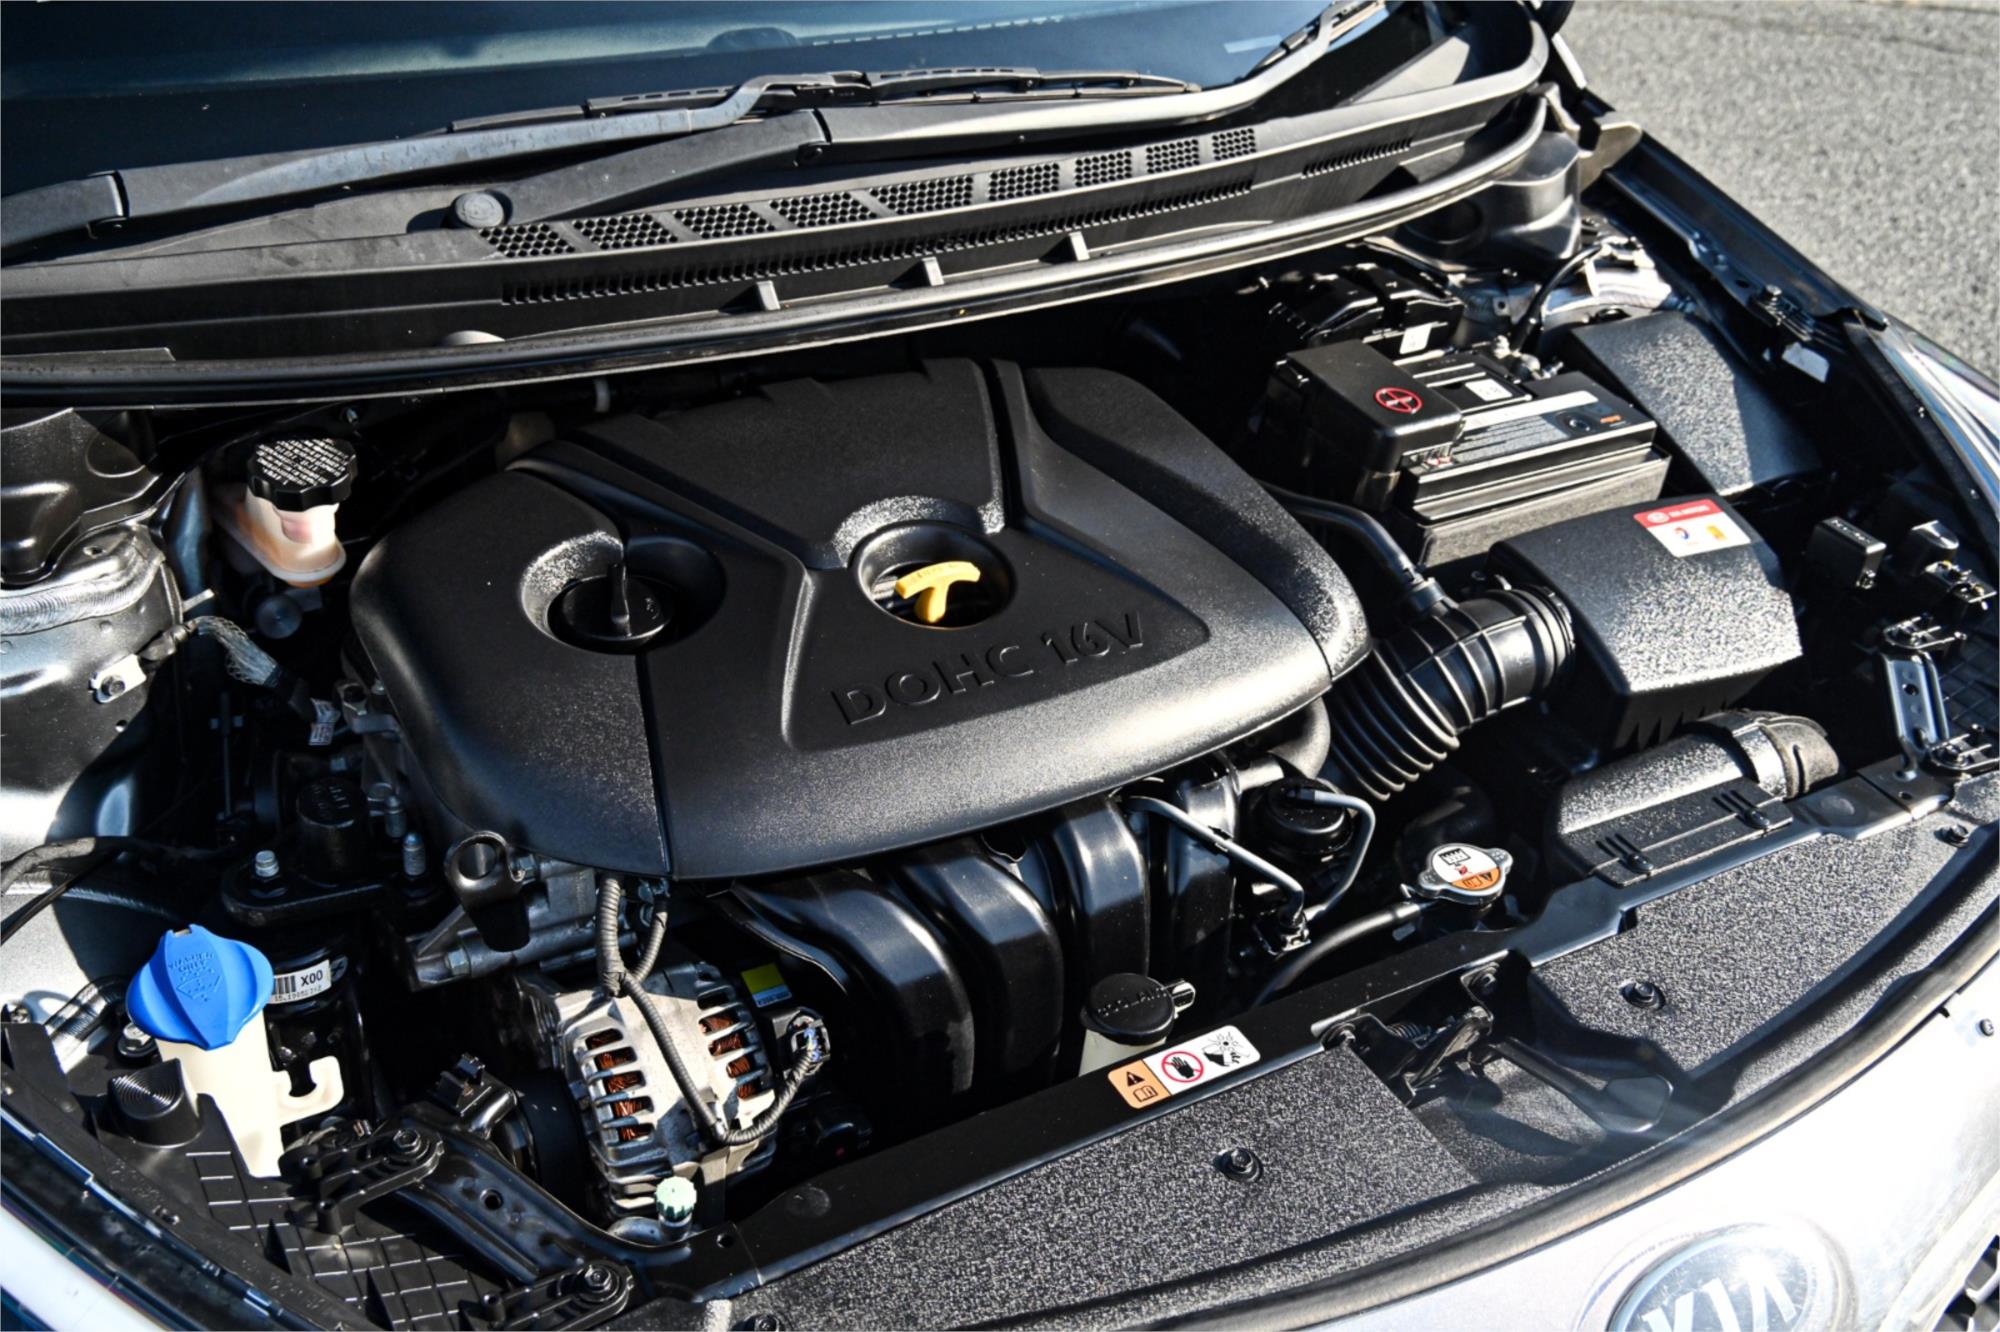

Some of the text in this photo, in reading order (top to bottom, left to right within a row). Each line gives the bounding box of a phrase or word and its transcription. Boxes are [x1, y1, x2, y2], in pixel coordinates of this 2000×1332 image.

[831, 612, 1143, 725] DOHC 16V
[301, 970, 323, 987] X00
